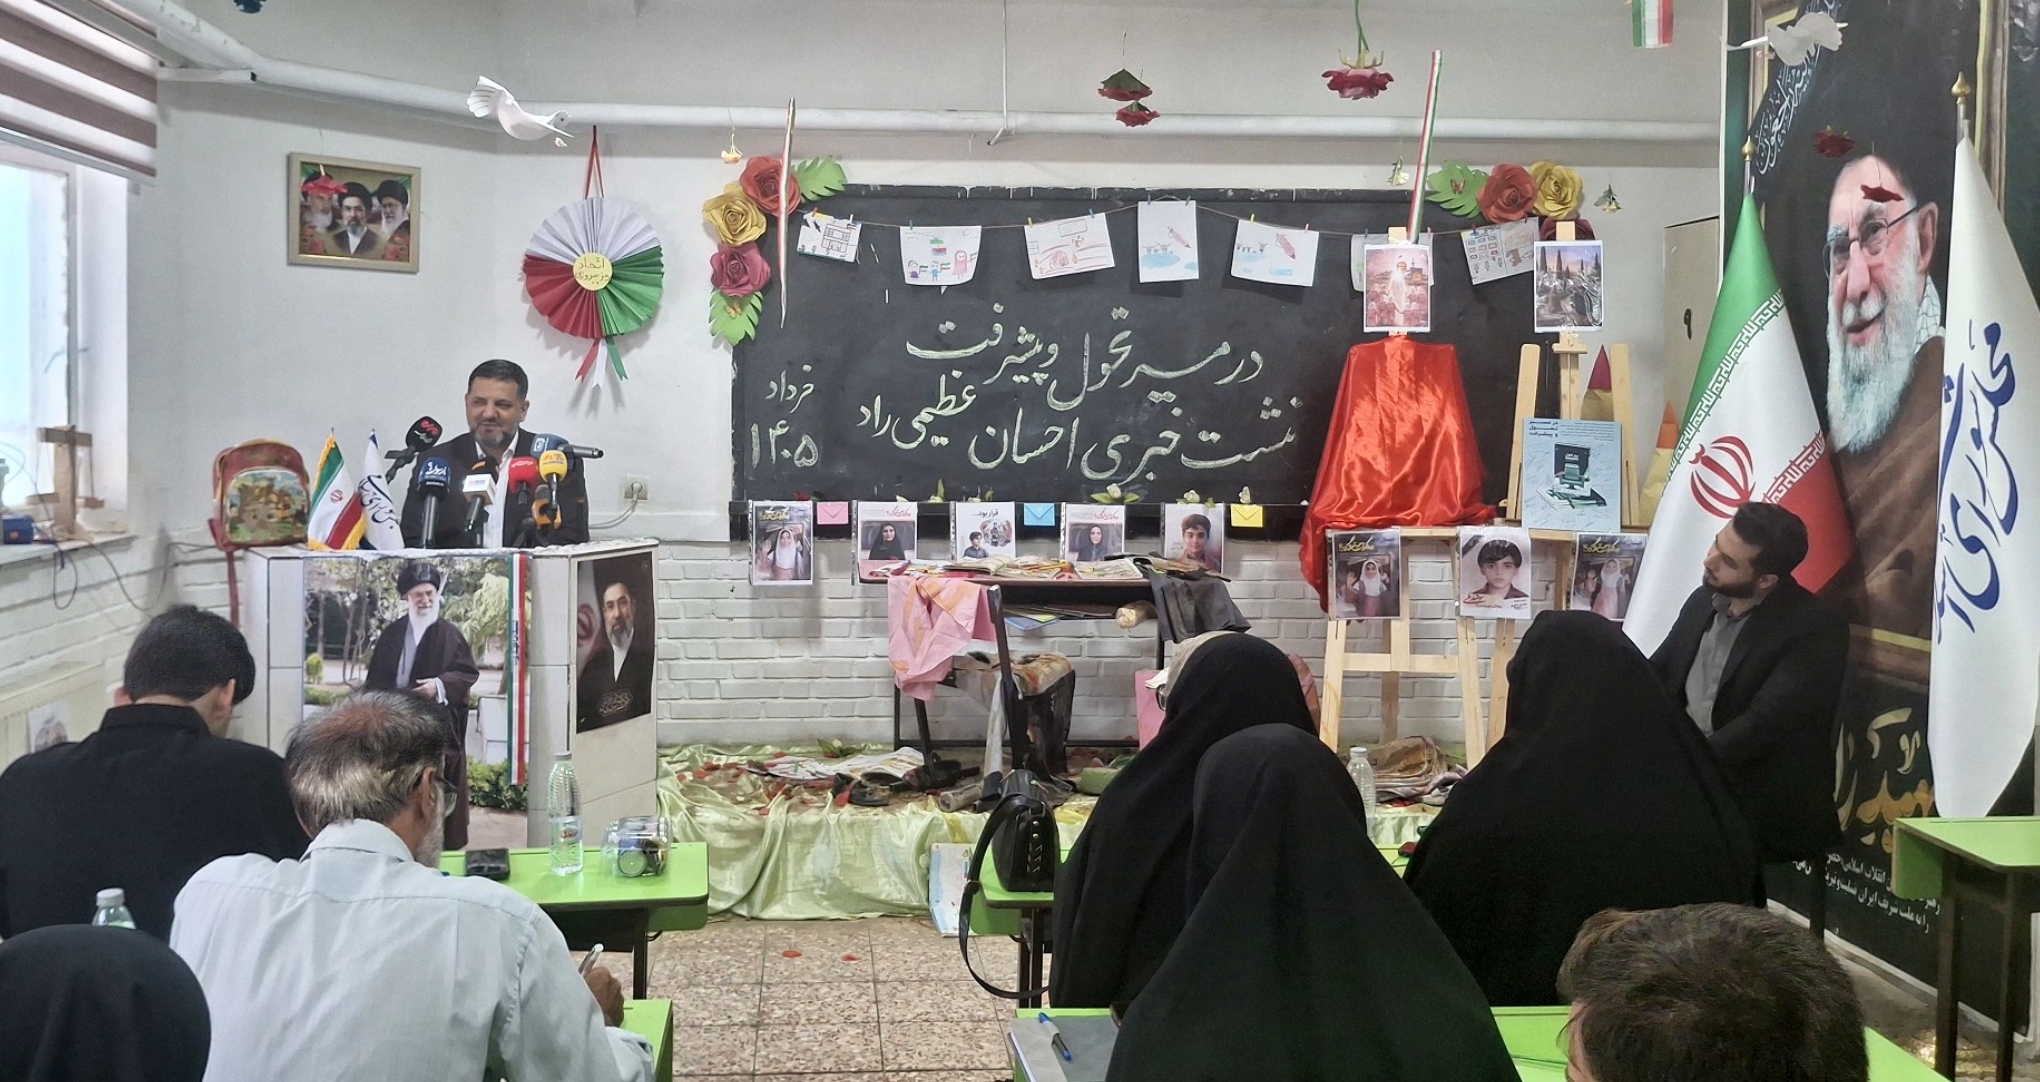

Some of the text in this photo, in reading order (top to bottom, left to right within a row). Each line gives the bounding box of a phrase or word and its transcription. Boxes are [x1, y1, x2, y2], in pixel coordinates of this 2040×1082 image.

[906, 303, 1050, 386] پیشرفت
[1047, 306, 1132, 411] تحول
[1117, 341, 1231, 403] مسیر
[764, 364, 814, 413] خرداد
[750, 420, 818, 469] ۱۴۰۵
[856, 369, 1303, 486] نشست خبری احسان عظیمی راد
